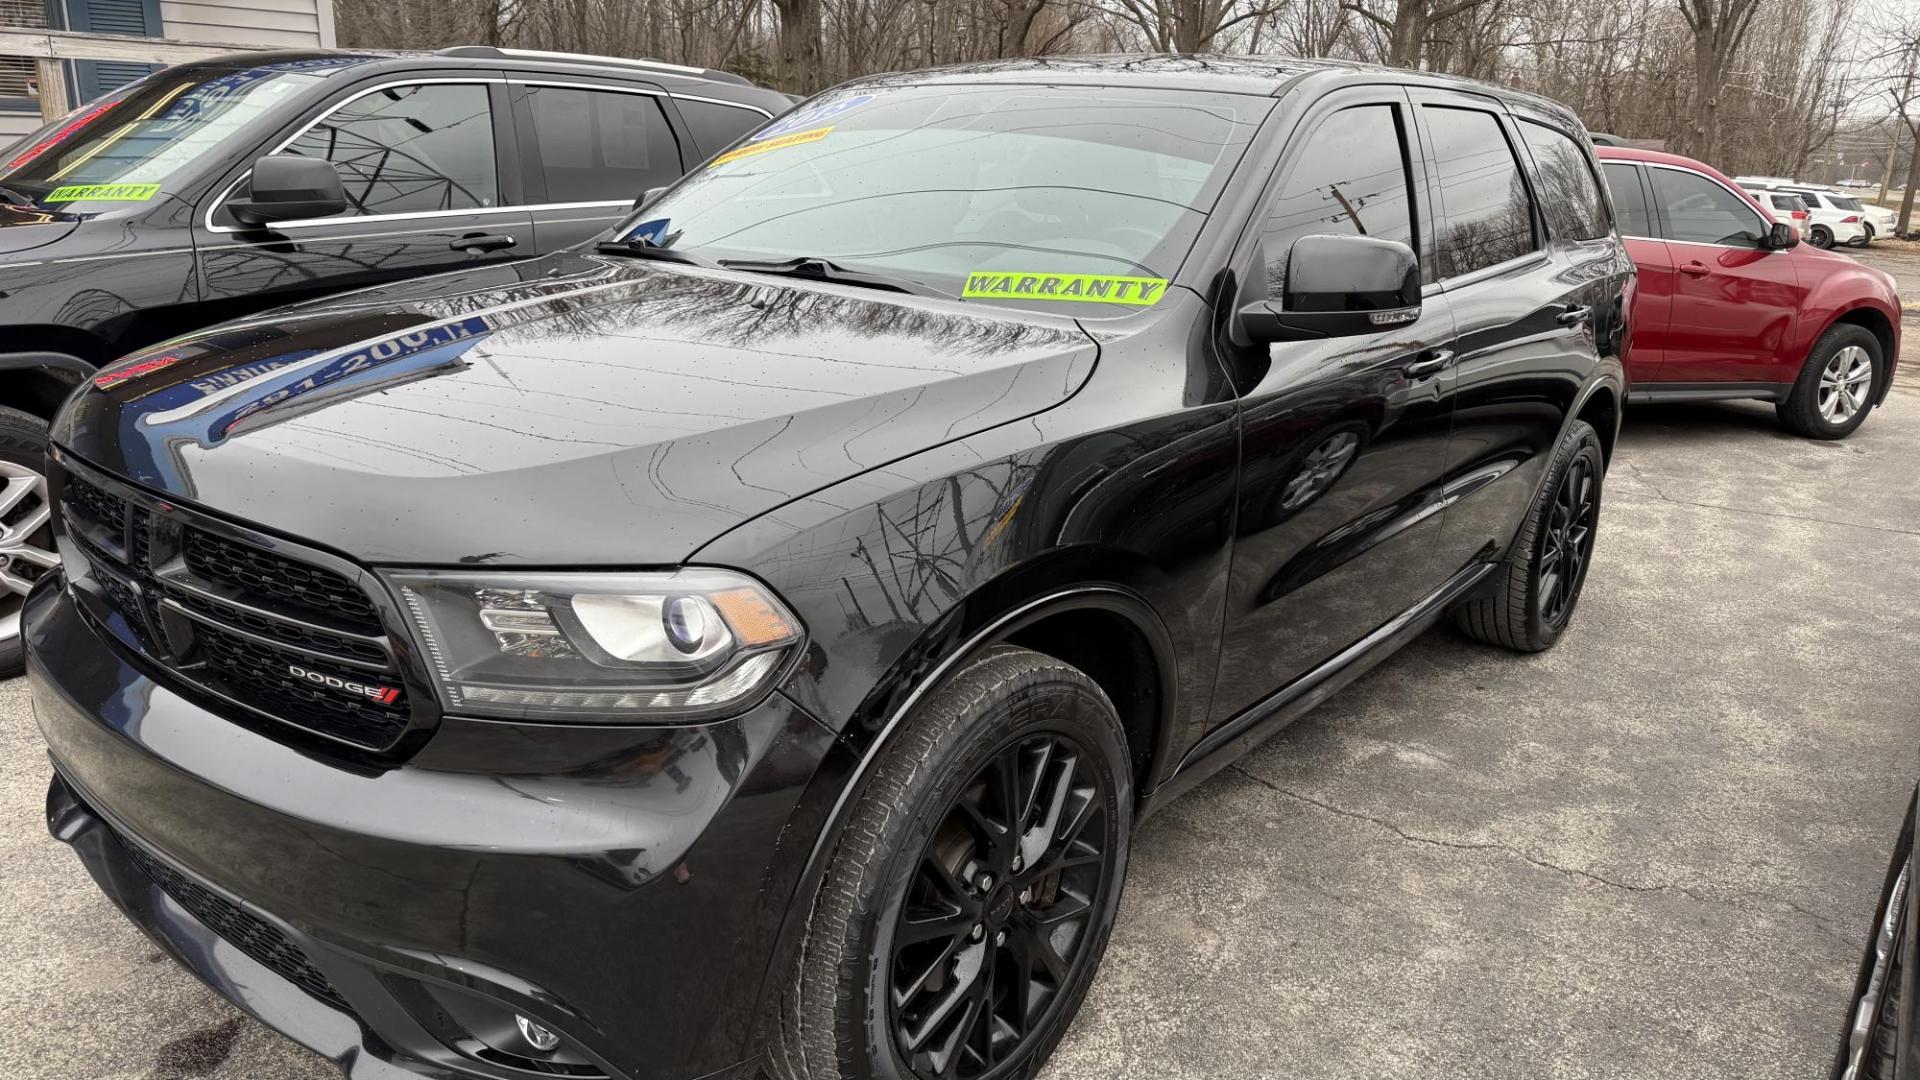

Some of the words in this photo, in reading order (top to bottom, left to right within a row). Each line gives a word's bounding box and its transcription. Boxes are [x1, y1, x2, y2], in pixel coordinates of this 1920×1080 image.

[49, 186, 156, 199] WARRANTY
[967, 275, 1161, 300] WARRANTY
[289, 665, 384, 699] DODGE
